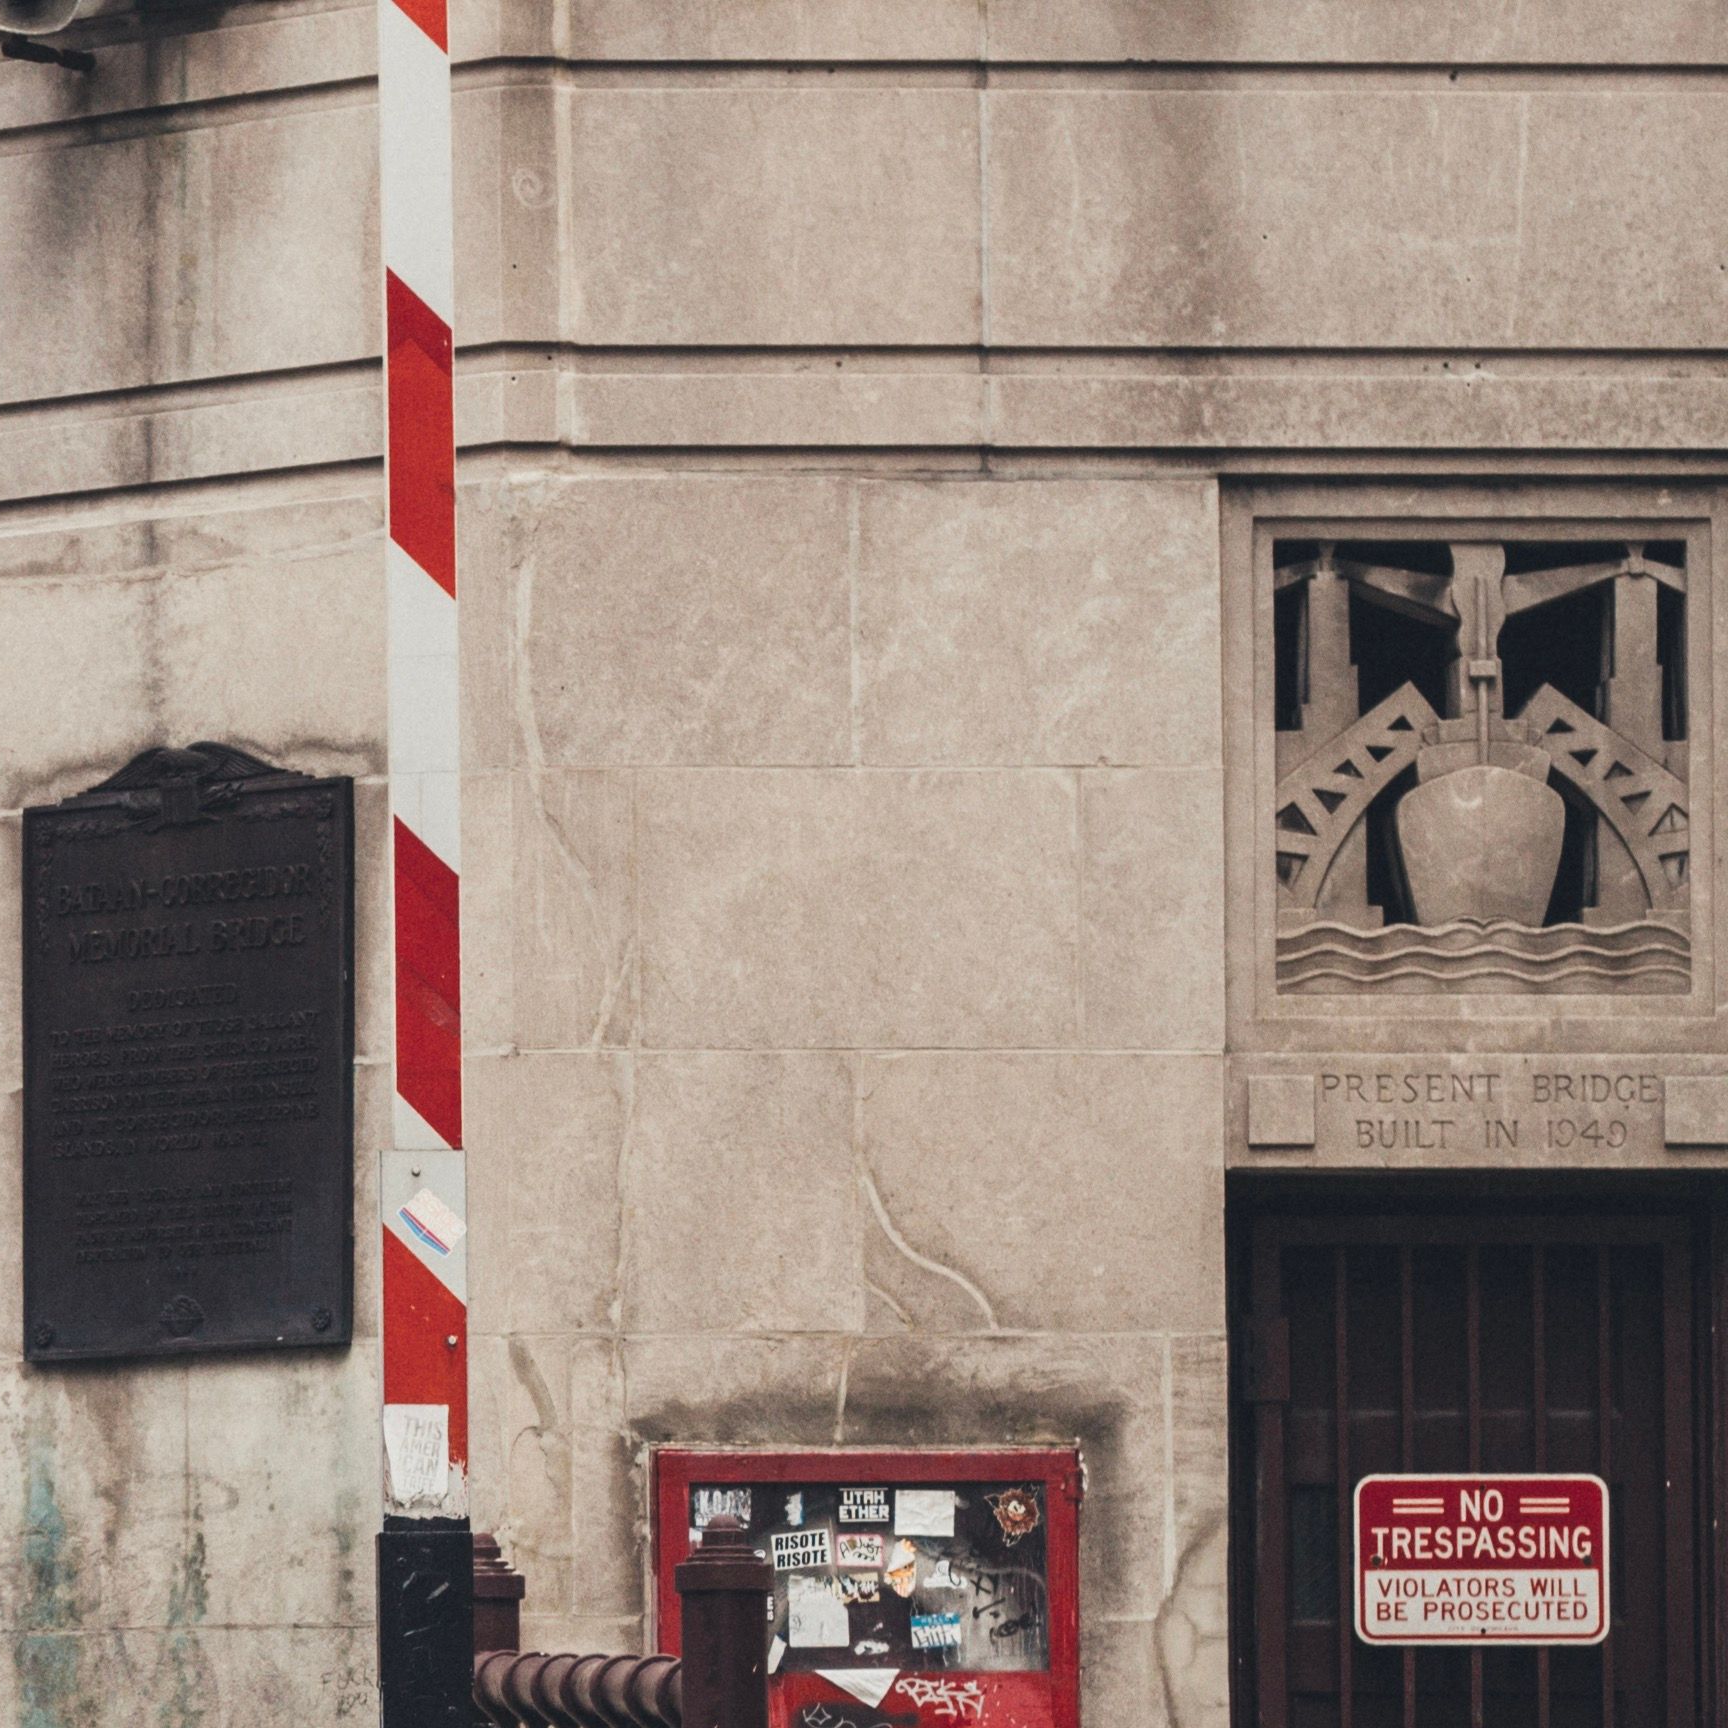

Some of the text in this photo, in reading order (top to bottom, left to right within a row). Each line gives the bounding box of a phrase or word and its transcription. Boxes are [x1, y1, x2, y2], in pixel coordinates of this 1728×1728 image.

[69, 913, 306, 965] MEMORIAL BRIDGE
[128, 983, 238, 1011] DEDICATED
[1321, 1074, 1659, 1104] PRESENT BRIDGE
[1355, 1119, 1454, 1149] BUILT
[1484, 1119, 1519, 1149] IN
[404, 1415, 444, 1440] THIS
[843, 1490, 885, 1505] UTAH
[1460, 1489, 1503, 1522] NO
[839, 1504, 890, 1519] ETHER
[775, 1531, 826, 1551] RISOTE
[1371, 1525, 1592, 1560] TRESPASSING
[776, 1548, 828, 1568] RISOTE
[1378, 1578, 1587, 1597] VIOLATORS WILL
[1376, 1602, 1588, 1621] BE PROSECUTED
